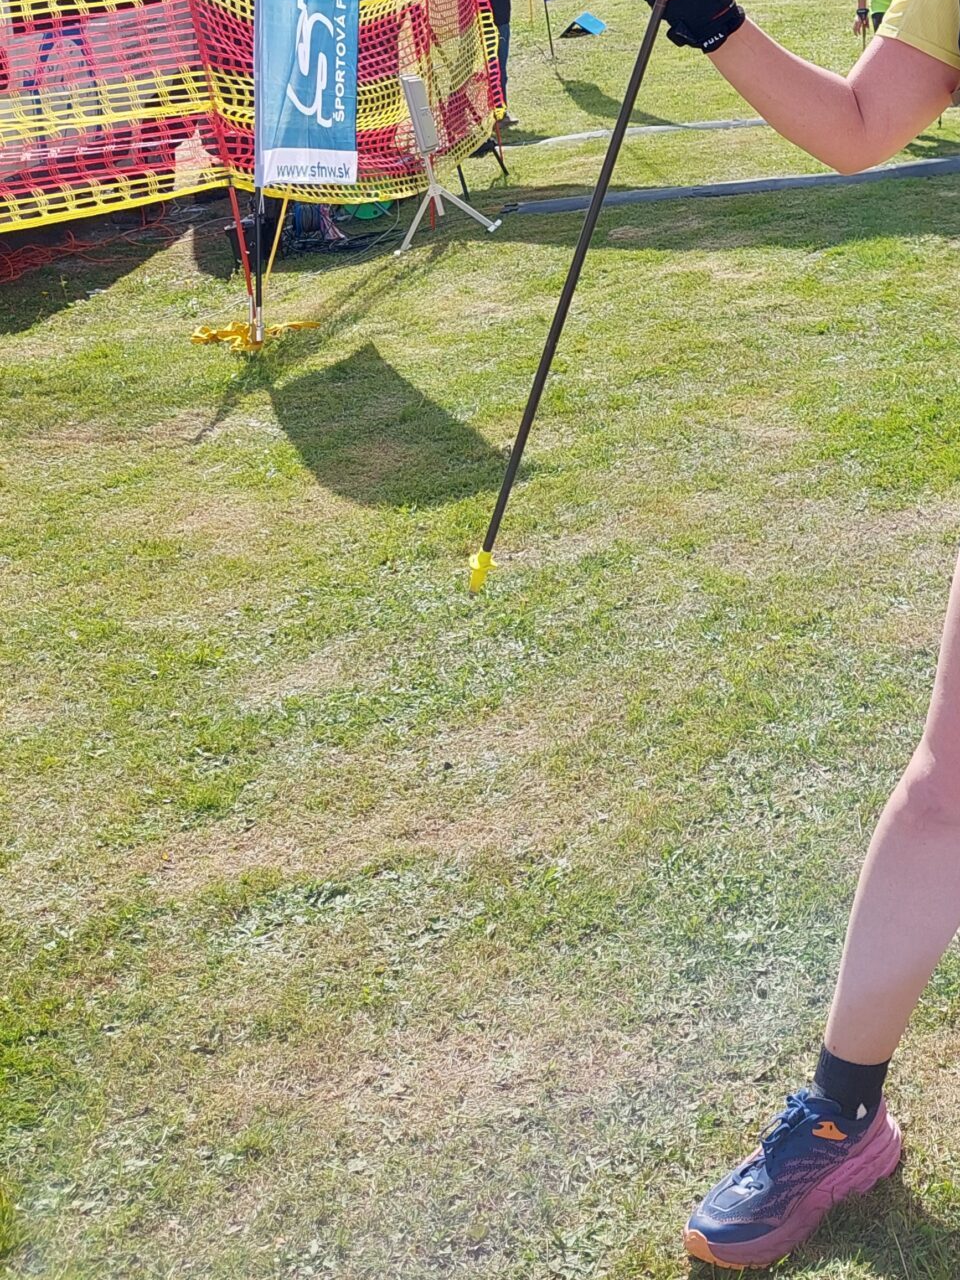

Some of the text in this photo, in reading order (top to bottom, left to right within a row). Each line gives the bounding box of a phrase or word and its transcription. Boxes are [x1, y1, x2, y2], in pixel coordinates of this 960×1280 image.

[702, 32, 725, 48] PULL
[331, 14, 347, 122] ŠPORTOVÁ
[276, 161, 350, 180] www.sfnw.sk
